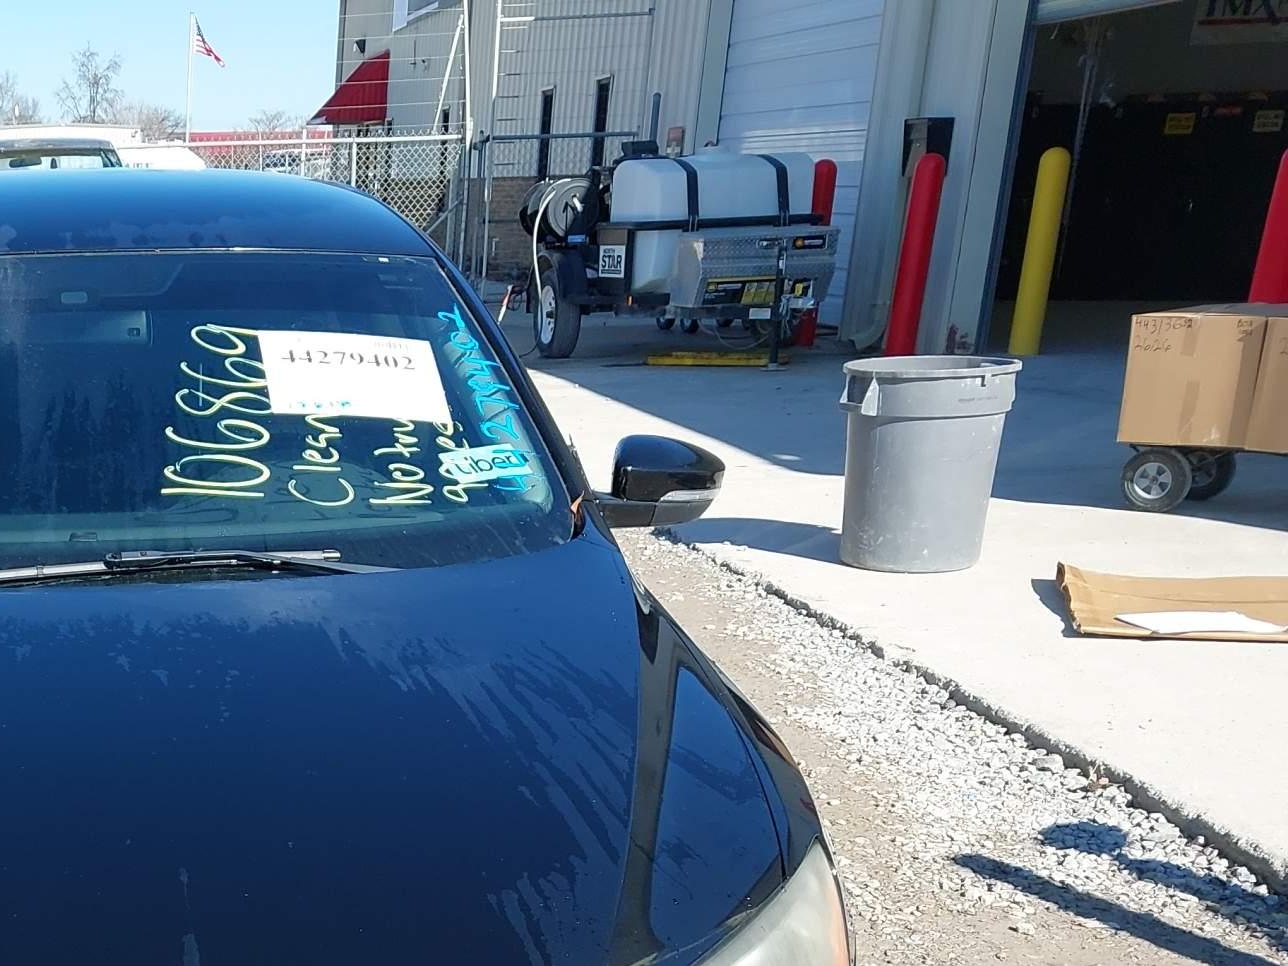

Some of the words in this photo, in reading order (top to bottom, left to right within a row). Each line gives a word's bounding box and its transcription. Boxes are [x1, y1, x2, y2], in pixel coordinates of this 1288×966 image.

[601, 254, 622, 269] STAR
[281, 349, 415, 370] 44279402
[160, 323, 272, 498] 106869
[368, 463, 435, 504] No
